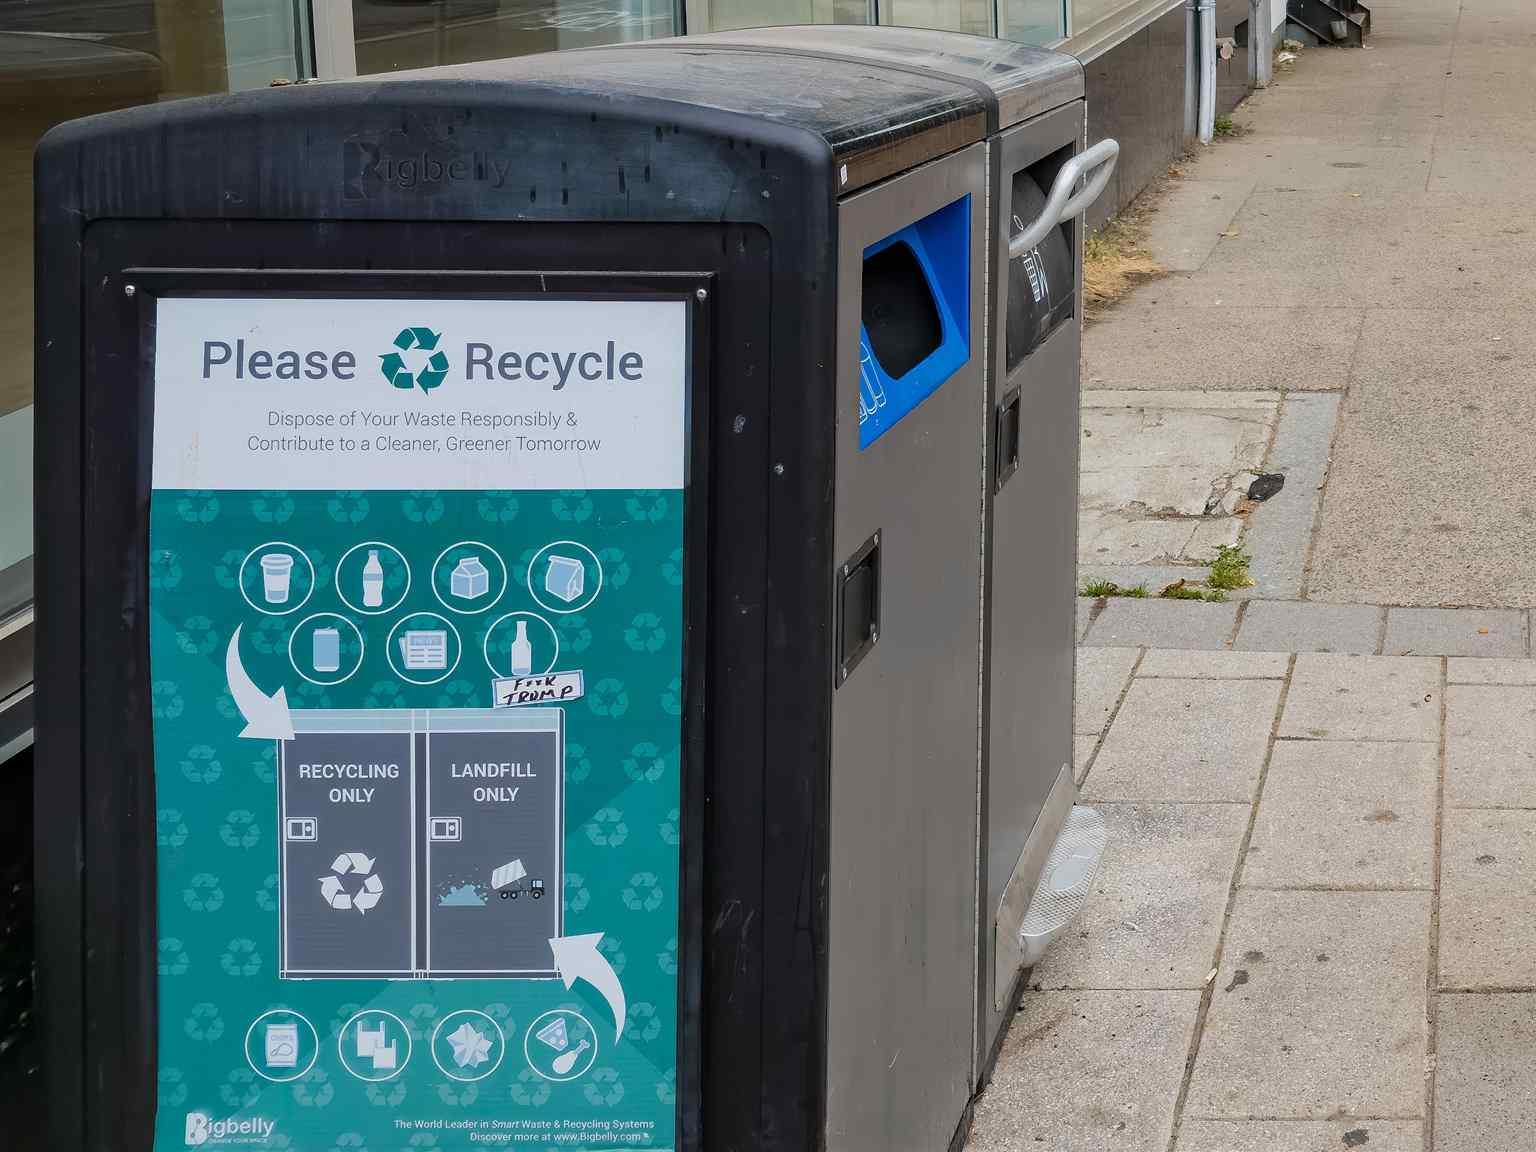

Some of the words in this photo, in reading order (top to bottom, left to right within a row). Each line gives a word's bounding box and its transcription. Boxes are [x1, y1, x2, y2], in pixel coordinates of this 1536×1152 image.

[202, 339, 357, 381] Please
[465, 340, 644, 391] Recycle
[267, 411, 336, 430] Dispose
[339, 410, 357, 427] of
[360, 411, 400, 427] Your
[404, 411, 456, 427] Waste
[460, 411, 562, 430] Responsibly
[566, 411, 578, 427] &
[247, 435, 334, 452] Contribute
[340, 437, 356, 452] to
[359, 438, 371, 452] a
[375, 435, 442, 455] Cleaner,
[446, 436, 512, 452] Greener
[516, 436, 602, 452] Tomorrow
[299, 763, 400, 779] RECYCLING
[451, 762, 537, 778] LANDFILL
[329, 787, 375, 803] ONLY
[473, 787, 519, 803] ONLY
[185, 1112, 274, 1145] Bigbelly
[394, 1119, 412, 1129] The
[414, 1119, 442, 1129] World
[445, 1119, 477, 1129] Leader
[480, 1119, 489, 1129] in
[492, 1120, 519, 1129] Smart
[521, 1120, 551, 1129] Waste
[554, 1120, 560, 1129] &
[563, 1120, 610, 1131] Recycling
[613, 1120, 654, 1131] Systems
[470, 1132, 511, 1141] Discover
[541, 1133, 550, 1141] at
[553, 1132, 641, 1144] www.Bigbelly.com
